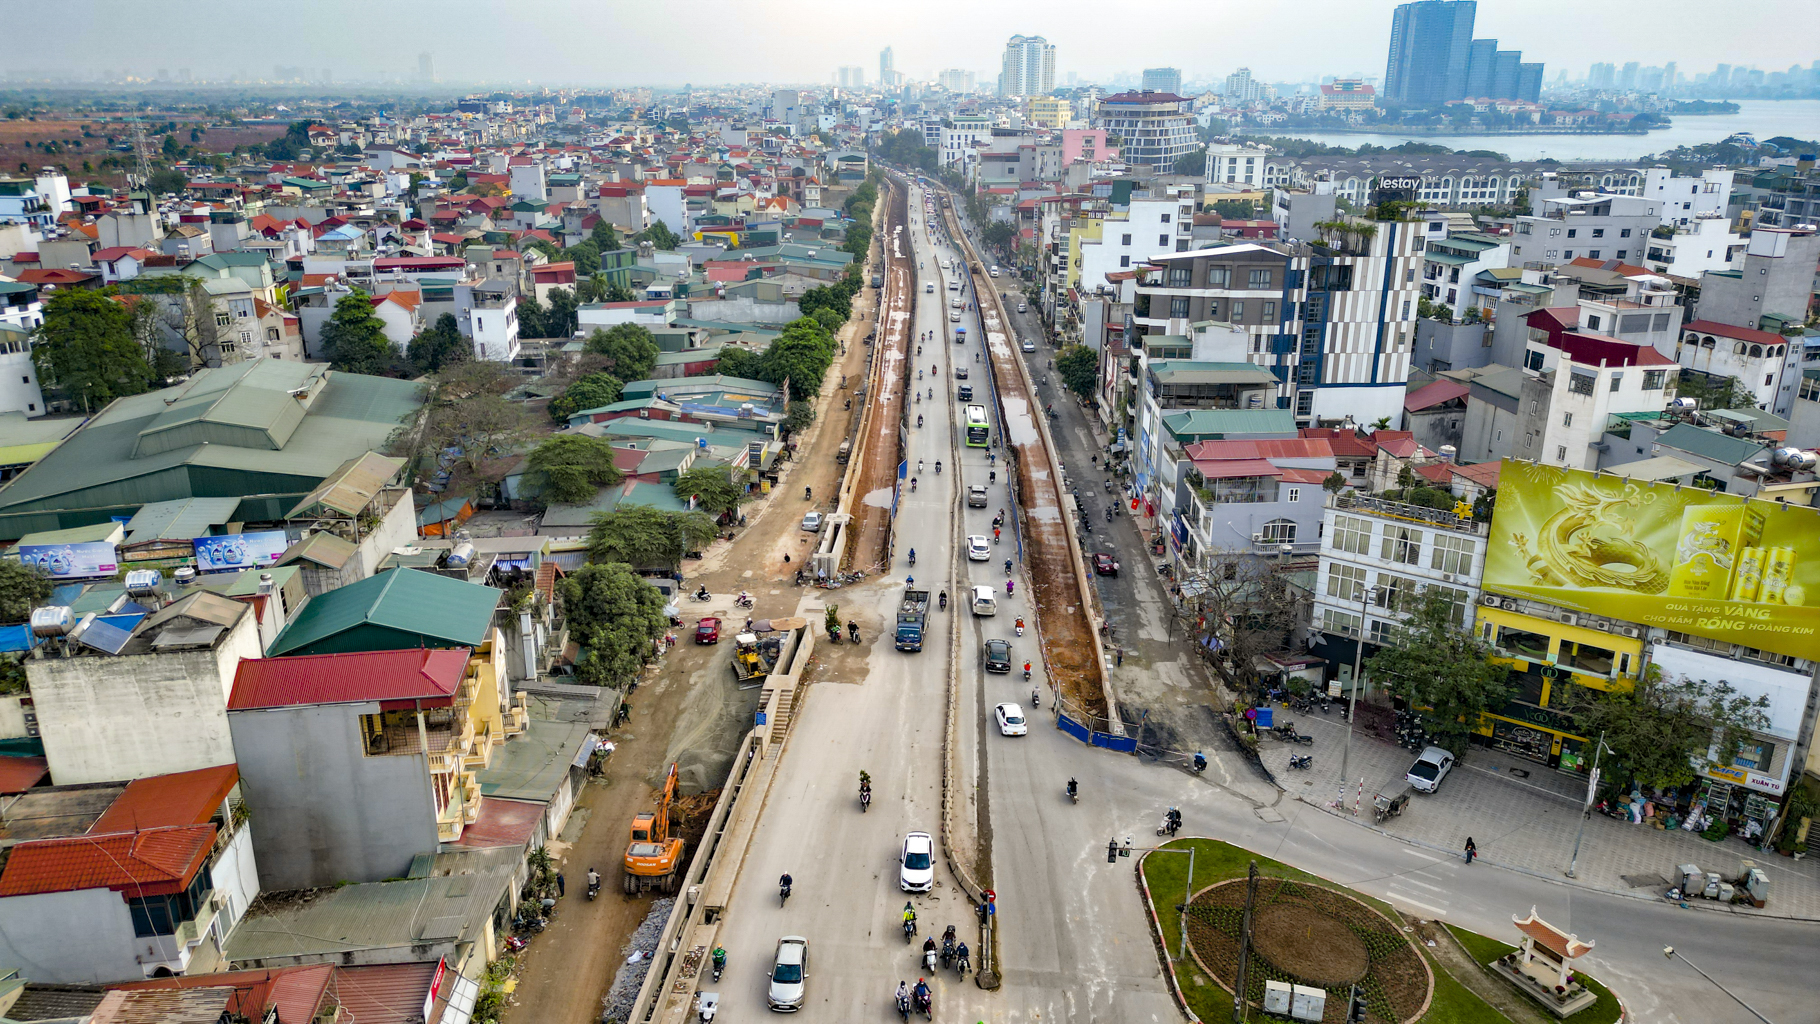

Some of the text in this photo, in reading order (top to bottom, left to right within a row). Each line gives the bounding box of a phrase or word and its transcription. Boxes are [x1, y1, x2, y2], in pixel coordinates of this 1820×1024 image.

[1379, 176, 1420, 190] lestay
[1665, 603, 1771, 619] QUÀ TẶNG VÀNG
[1642, 614, 1815, 635] CHO NĂM RỒNG HOÀNG KIM
[1712, 766, 1745, 778] MPE
